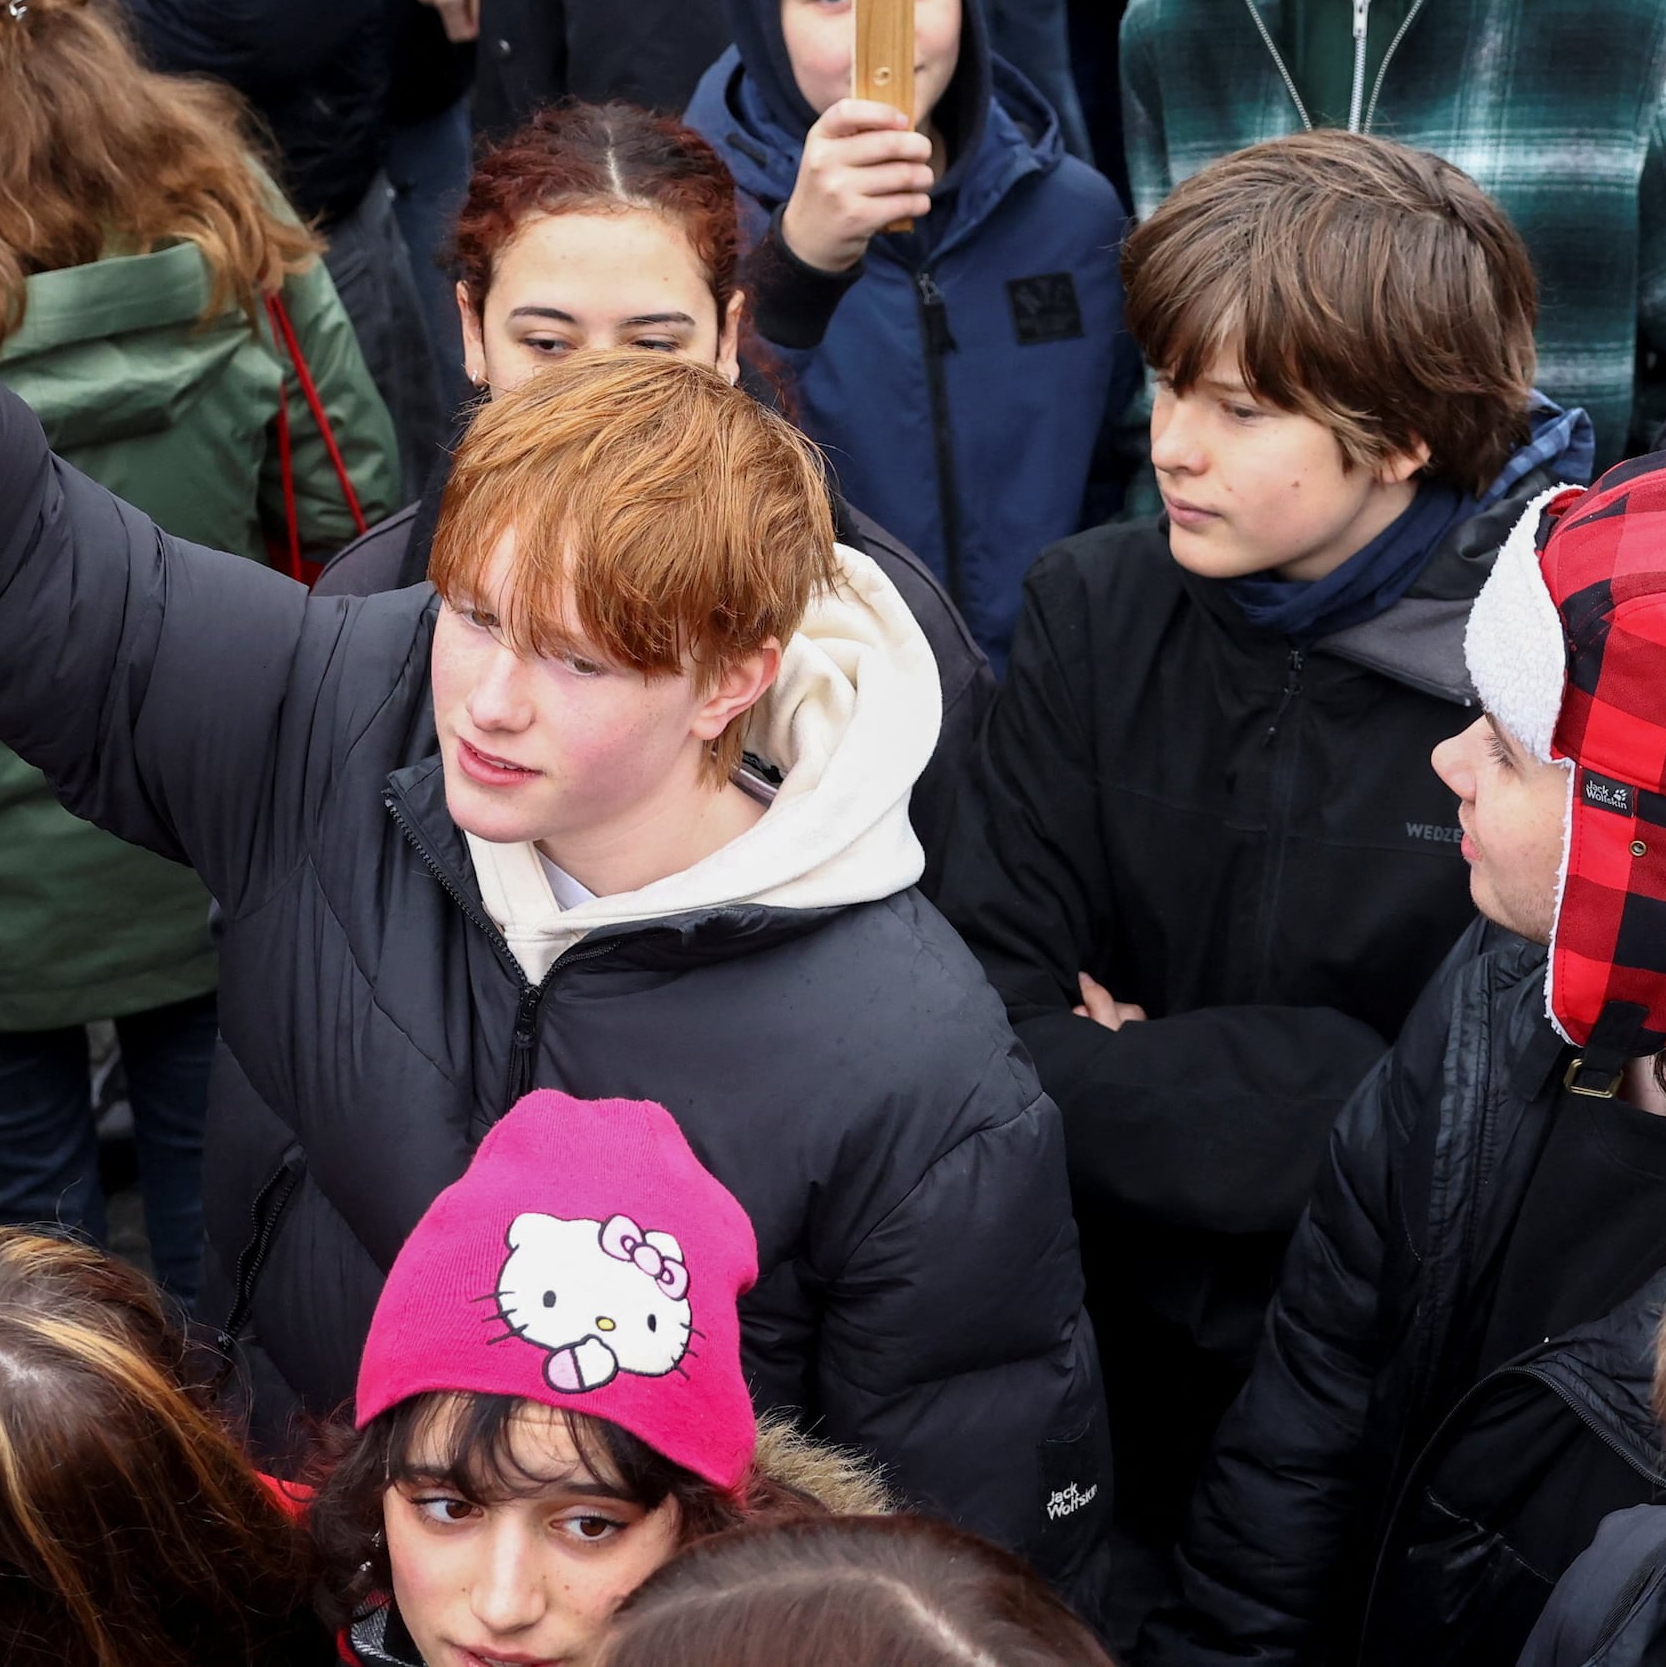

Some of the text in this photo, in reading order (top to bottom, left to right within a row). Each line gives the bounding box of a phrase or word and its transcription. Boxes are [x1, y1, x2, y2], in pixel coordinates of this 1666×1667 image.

[1586, 779, 1609, 796] Jack
[1586, 787, 1627, 809] Wolfskin
[1405, 821, 1463, 844] WEDZE
[1046, 1481, 1078, 1507] Jack
[1046, 1484, 1097, 1520] Wolfskin
